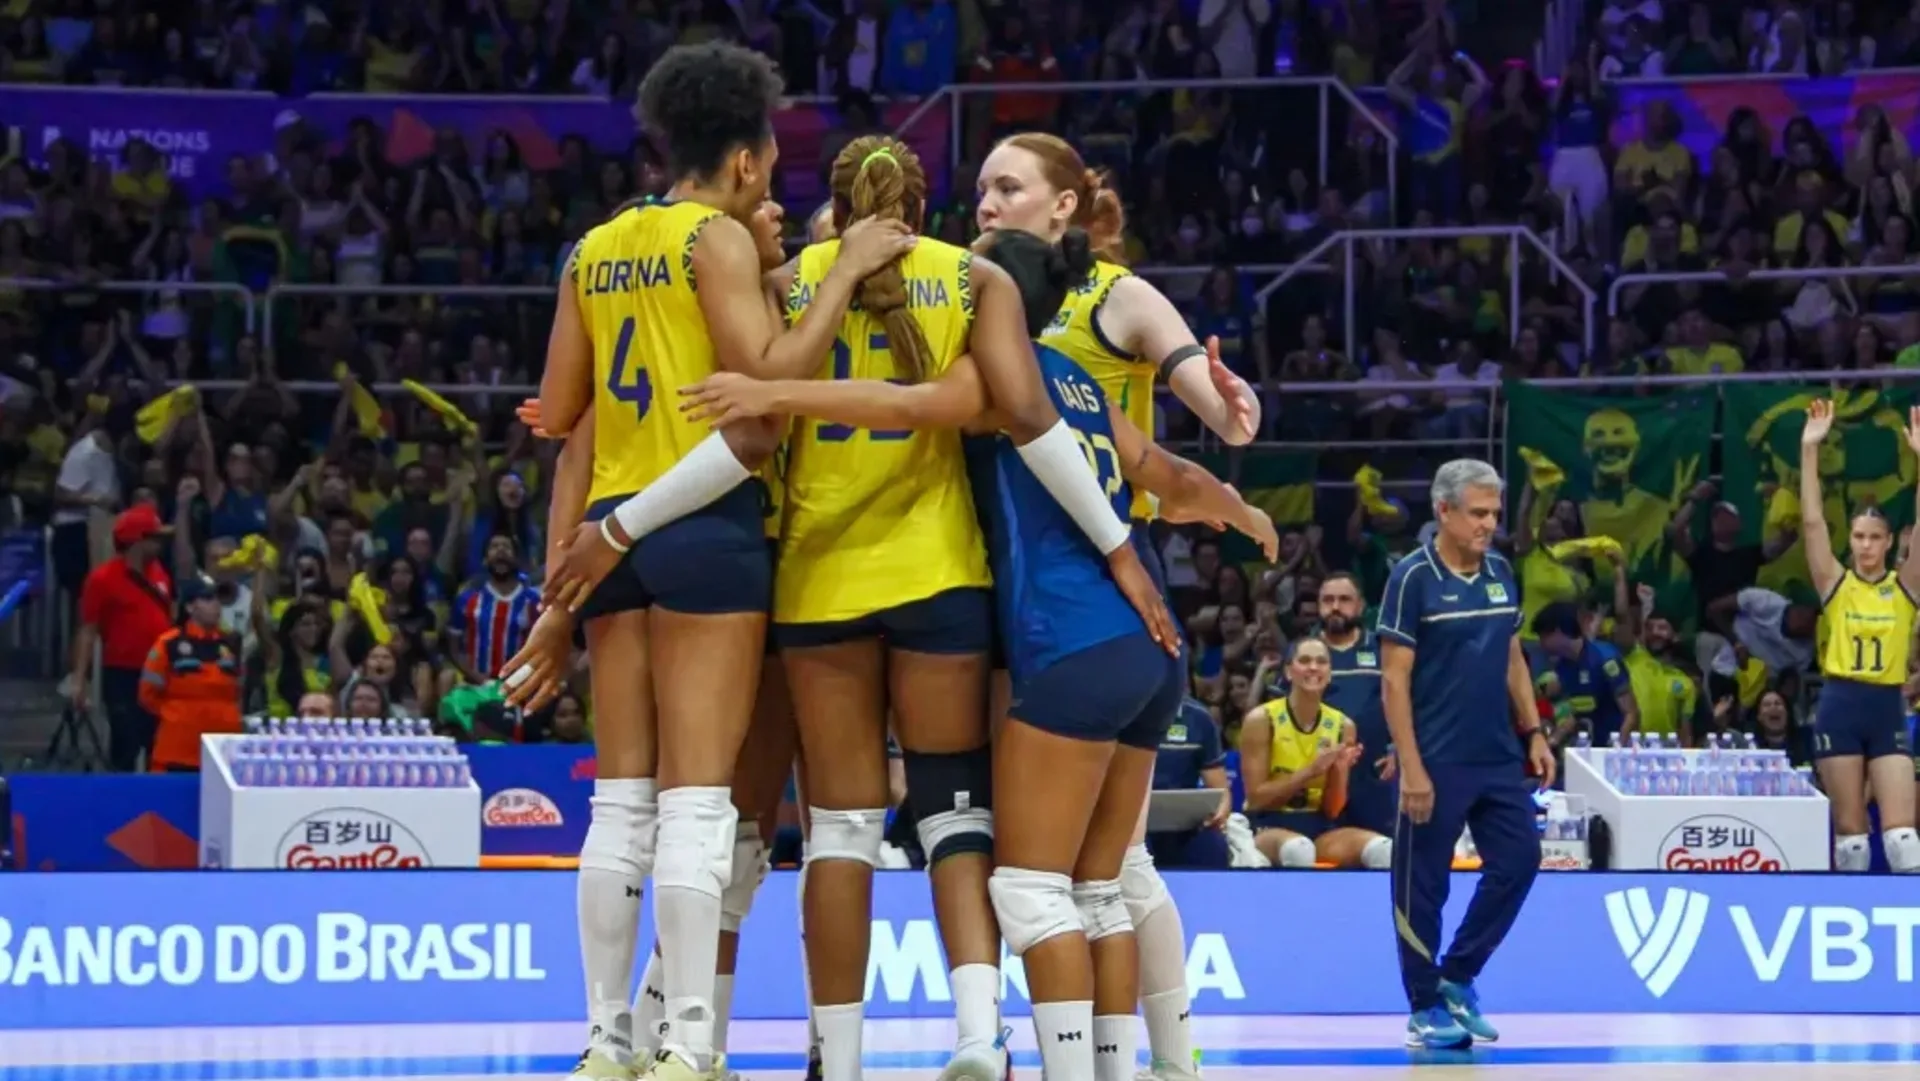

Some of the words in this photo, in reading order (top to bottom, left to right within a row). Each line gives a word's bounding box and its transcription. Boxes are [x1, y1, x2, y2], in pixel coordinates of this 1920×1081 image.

[607, 316, 653, 423] 4
[1851, 635, 1884, 671] 11
[306, 820, 391, 845] 百岁山
[1682, 826, 1755, 848] 百岁山
[0, 916, 204, 985] ANCO
[215, 924, 306, 984] DO
[317, 912, 546, 982] BRASIL
